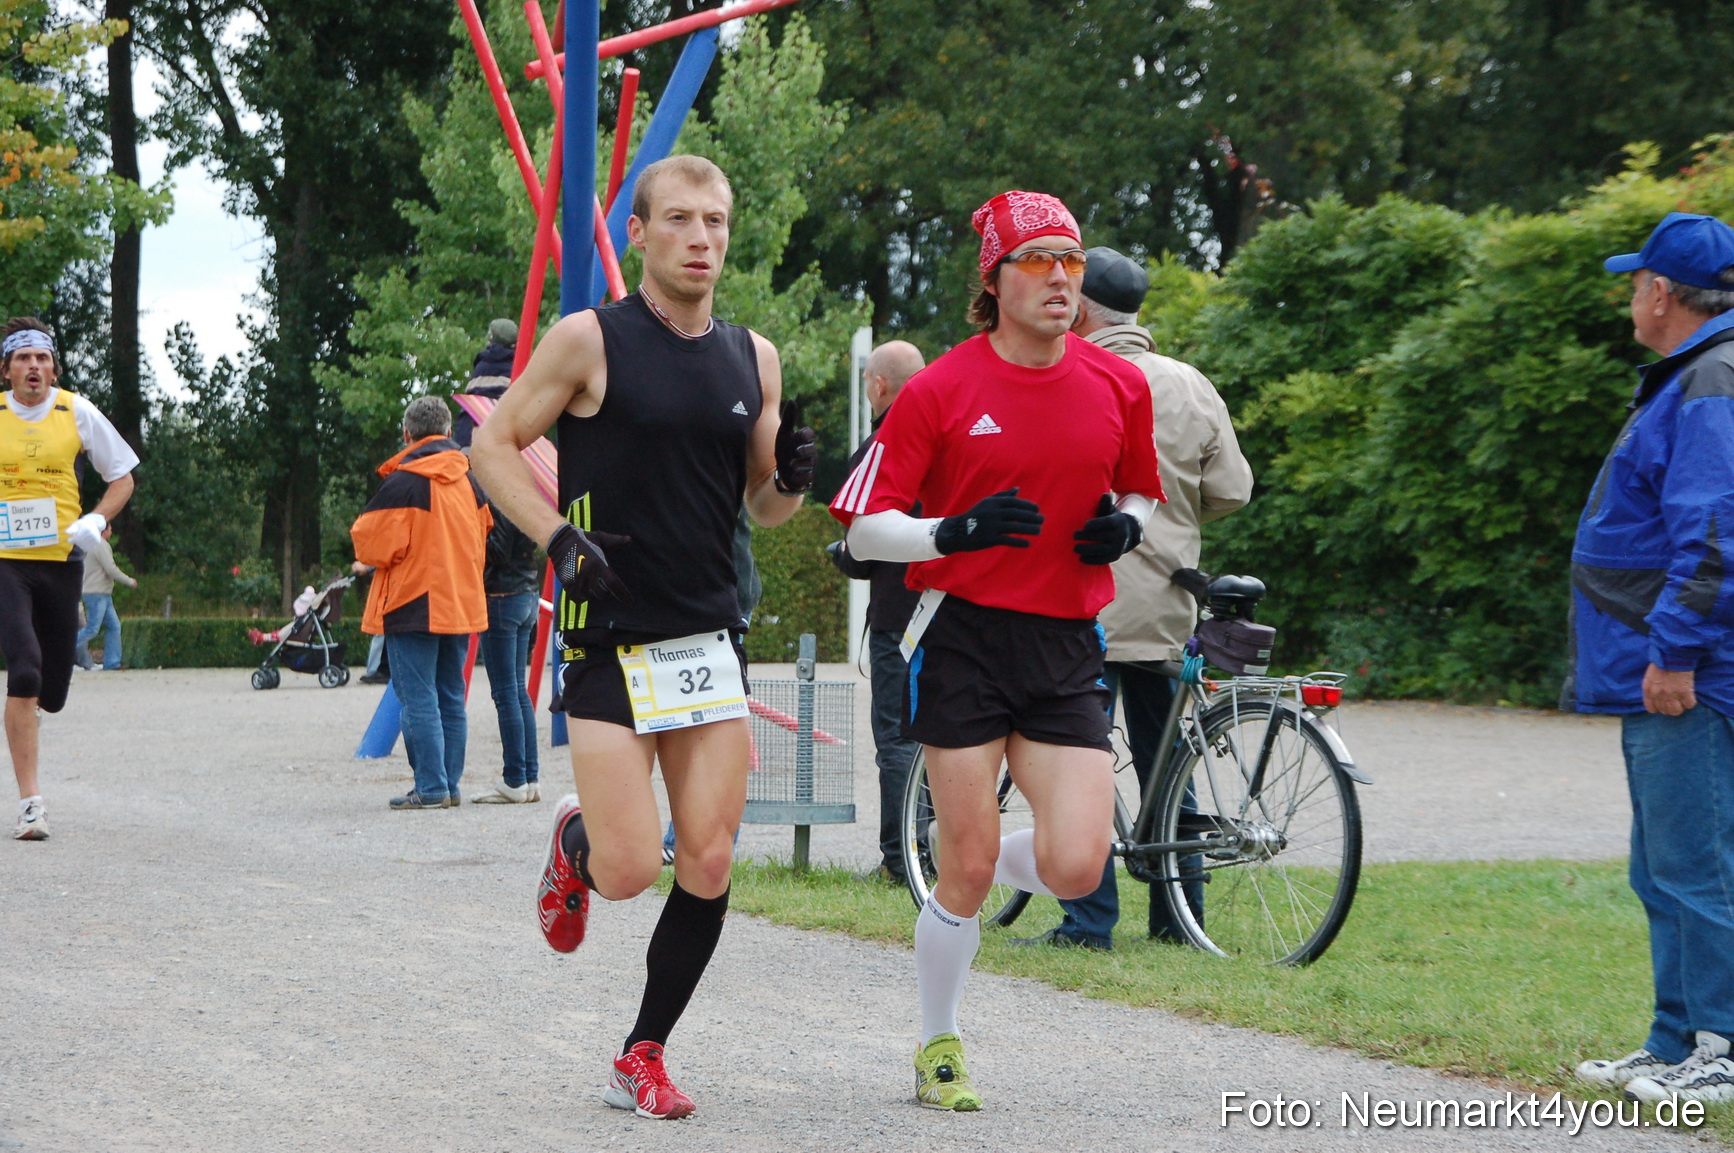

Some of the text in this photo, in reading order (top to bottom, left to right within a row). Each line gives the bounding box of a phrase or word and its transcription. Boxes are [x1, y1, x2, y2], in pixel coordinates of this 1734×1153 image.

[11, 505, 35, 515] Dieter
[14, 516, 51, 532] 2179
[649, 647, 706, 663] Thomas
[632, 675, 639, 689] A
[678, 666, 714, 695] 32
[703, 702, 746, 717] PFLEIDERER
